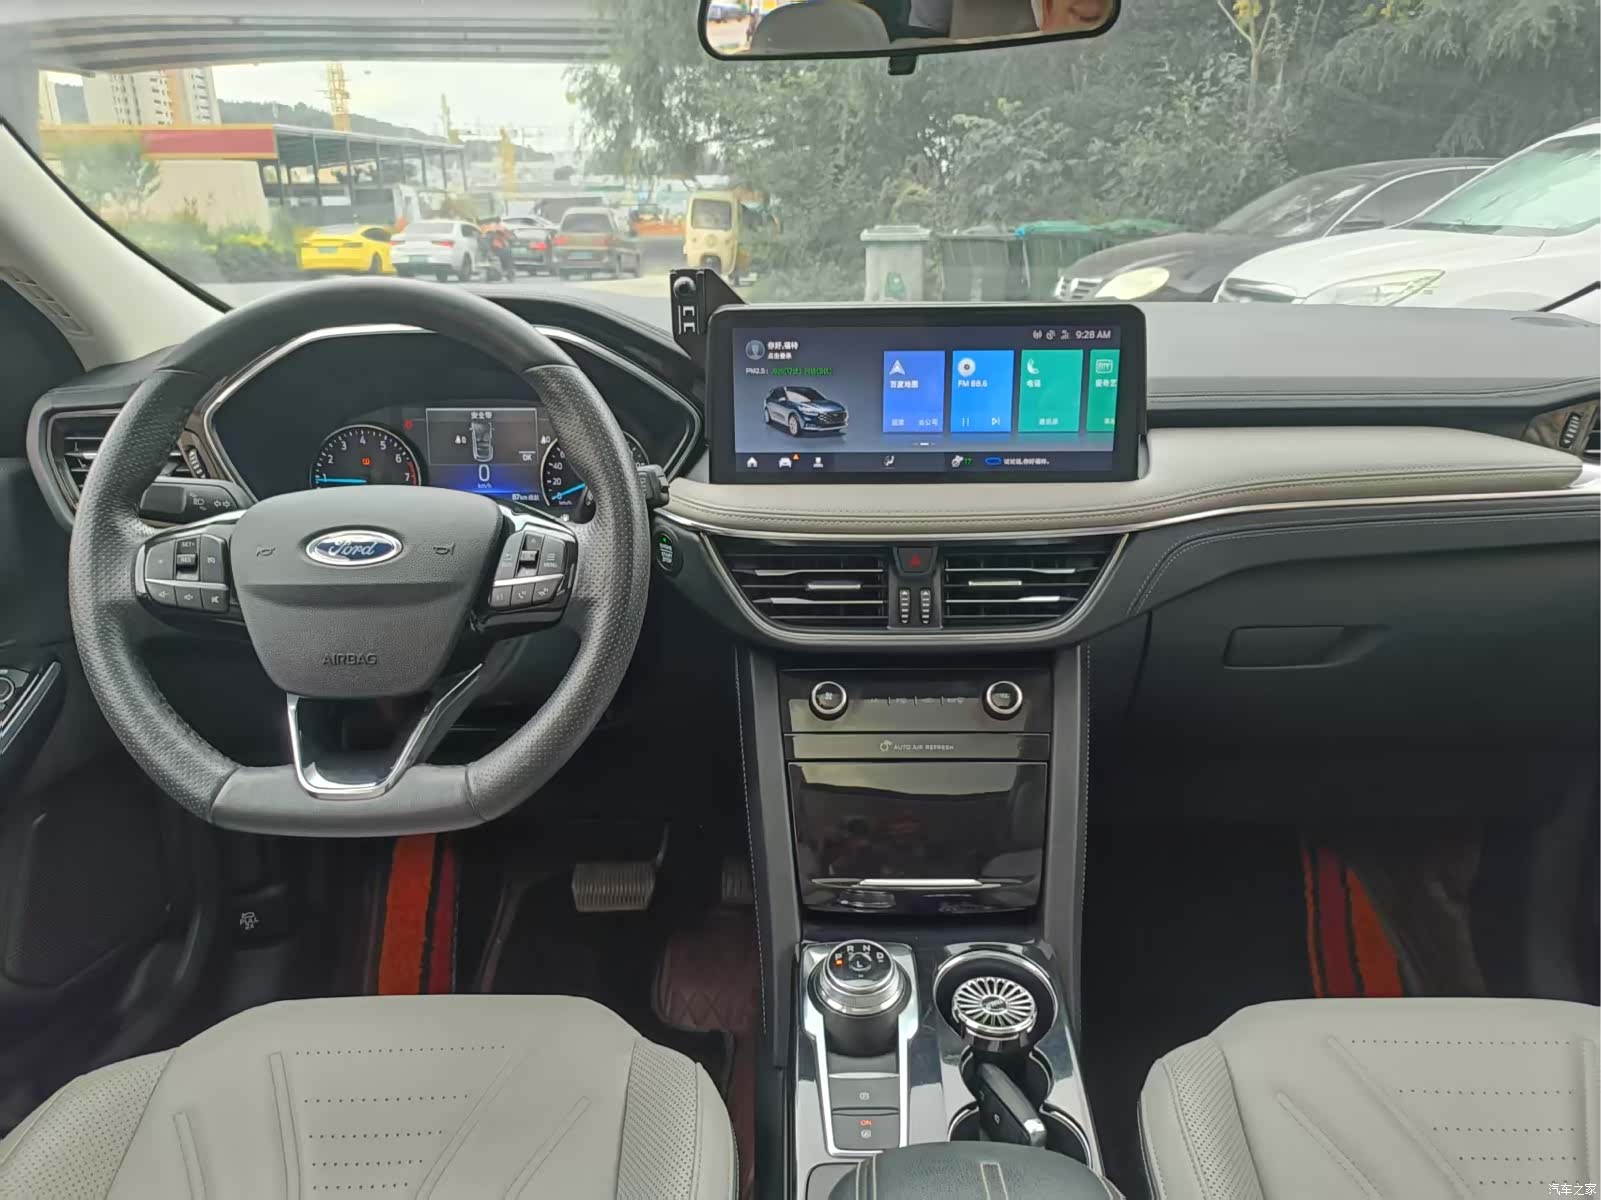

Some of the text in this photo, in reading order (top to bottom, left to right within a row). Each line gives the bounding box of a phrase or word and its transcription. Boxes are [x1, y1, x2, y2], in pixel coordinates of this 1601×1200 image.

[1075, 330, 1111, 339] 9:28 AM
[360, 435, 366, 445] 4
[341, 441, 347, 451] 3
[380, 441, 386, 450] 5
[327, 454, 334, 464] 2
[395, 453, 402, 463] 6
[553, 462, 563, 470] 40
[404, 473, 410, 482] 7
[479, 464, 490, 482] 0
[552, 478, 562, 486] 20
[328, 540, 377, 556] Ford
[322, 653, 378, 665] AIRBAG
[835, 953, 843, 961] P
[857, 960, 863, 968] L
